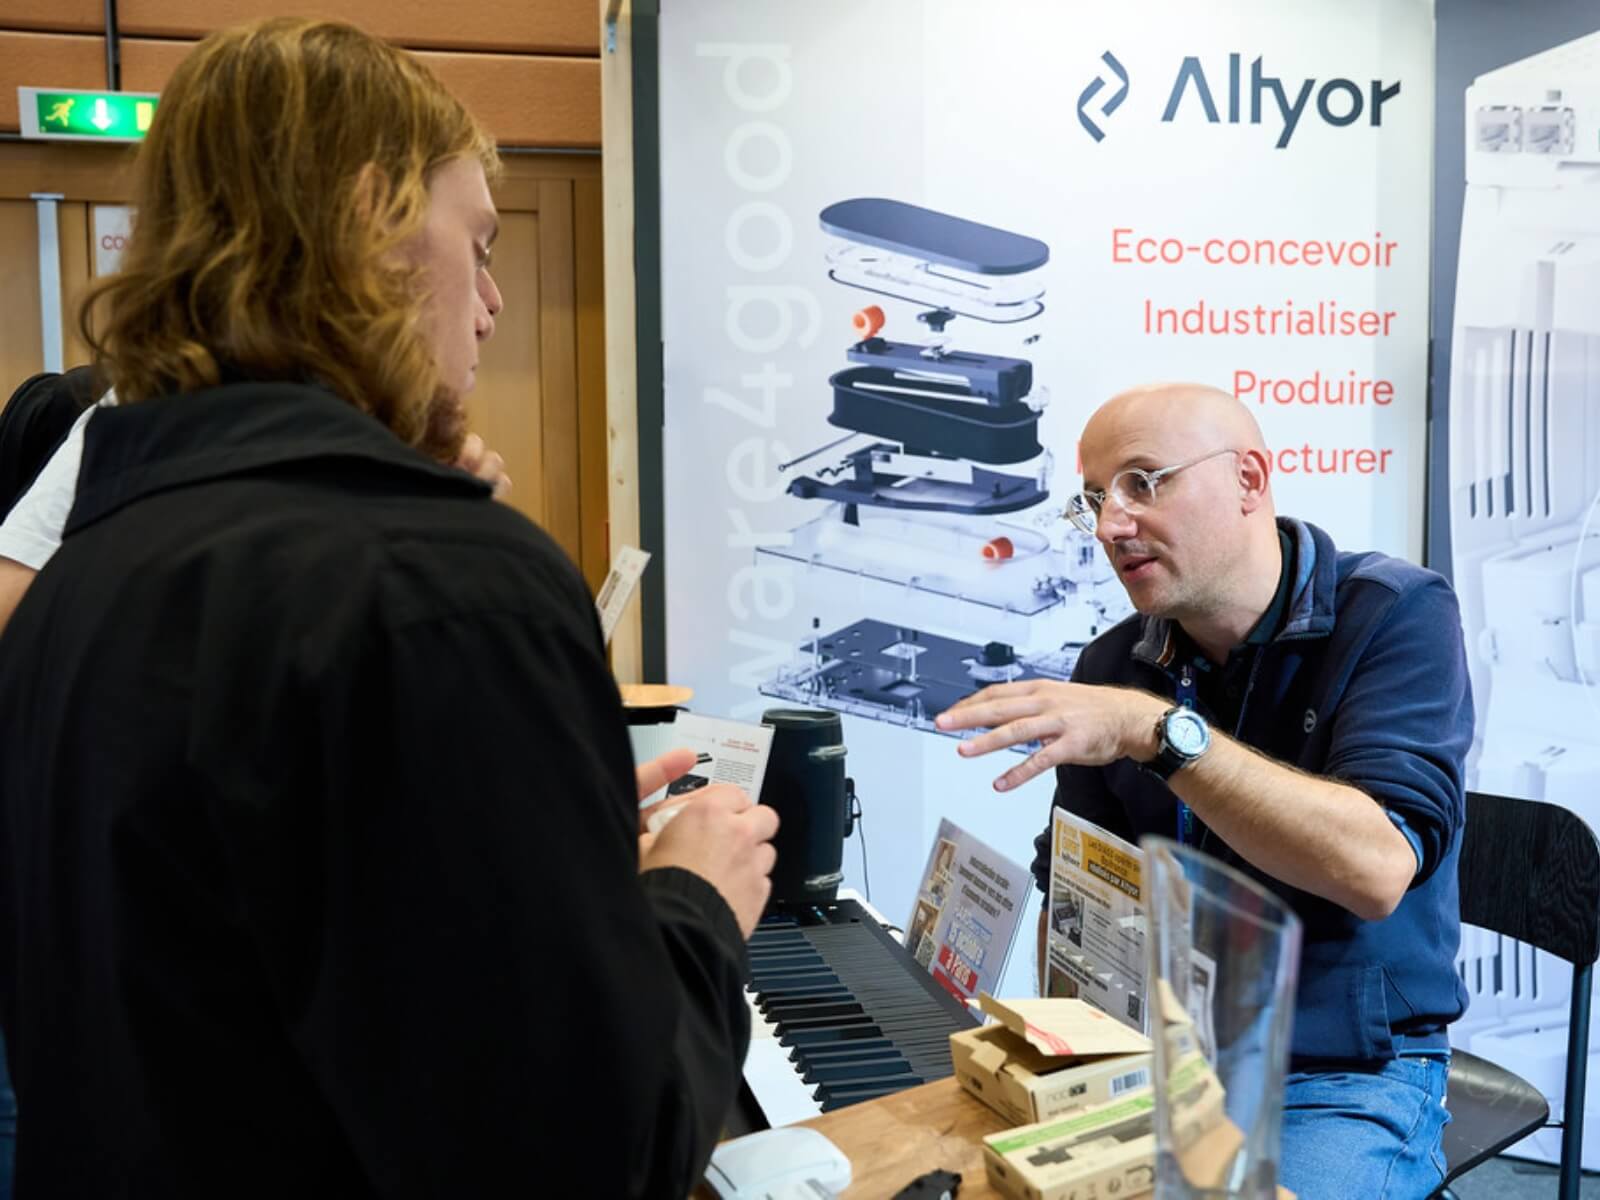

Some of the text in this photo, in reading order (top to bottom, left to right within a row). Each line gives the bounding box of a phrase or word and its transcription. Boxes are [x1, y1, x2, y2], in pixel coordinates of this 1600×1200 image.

[1161, 53, 1401, 149] Altyor
[1112, 228, 1398, 268] Eco-concevoir
[1145, 299, 1396, 336] Industrialiser
[1234, 370, 1394, 405] Produire
